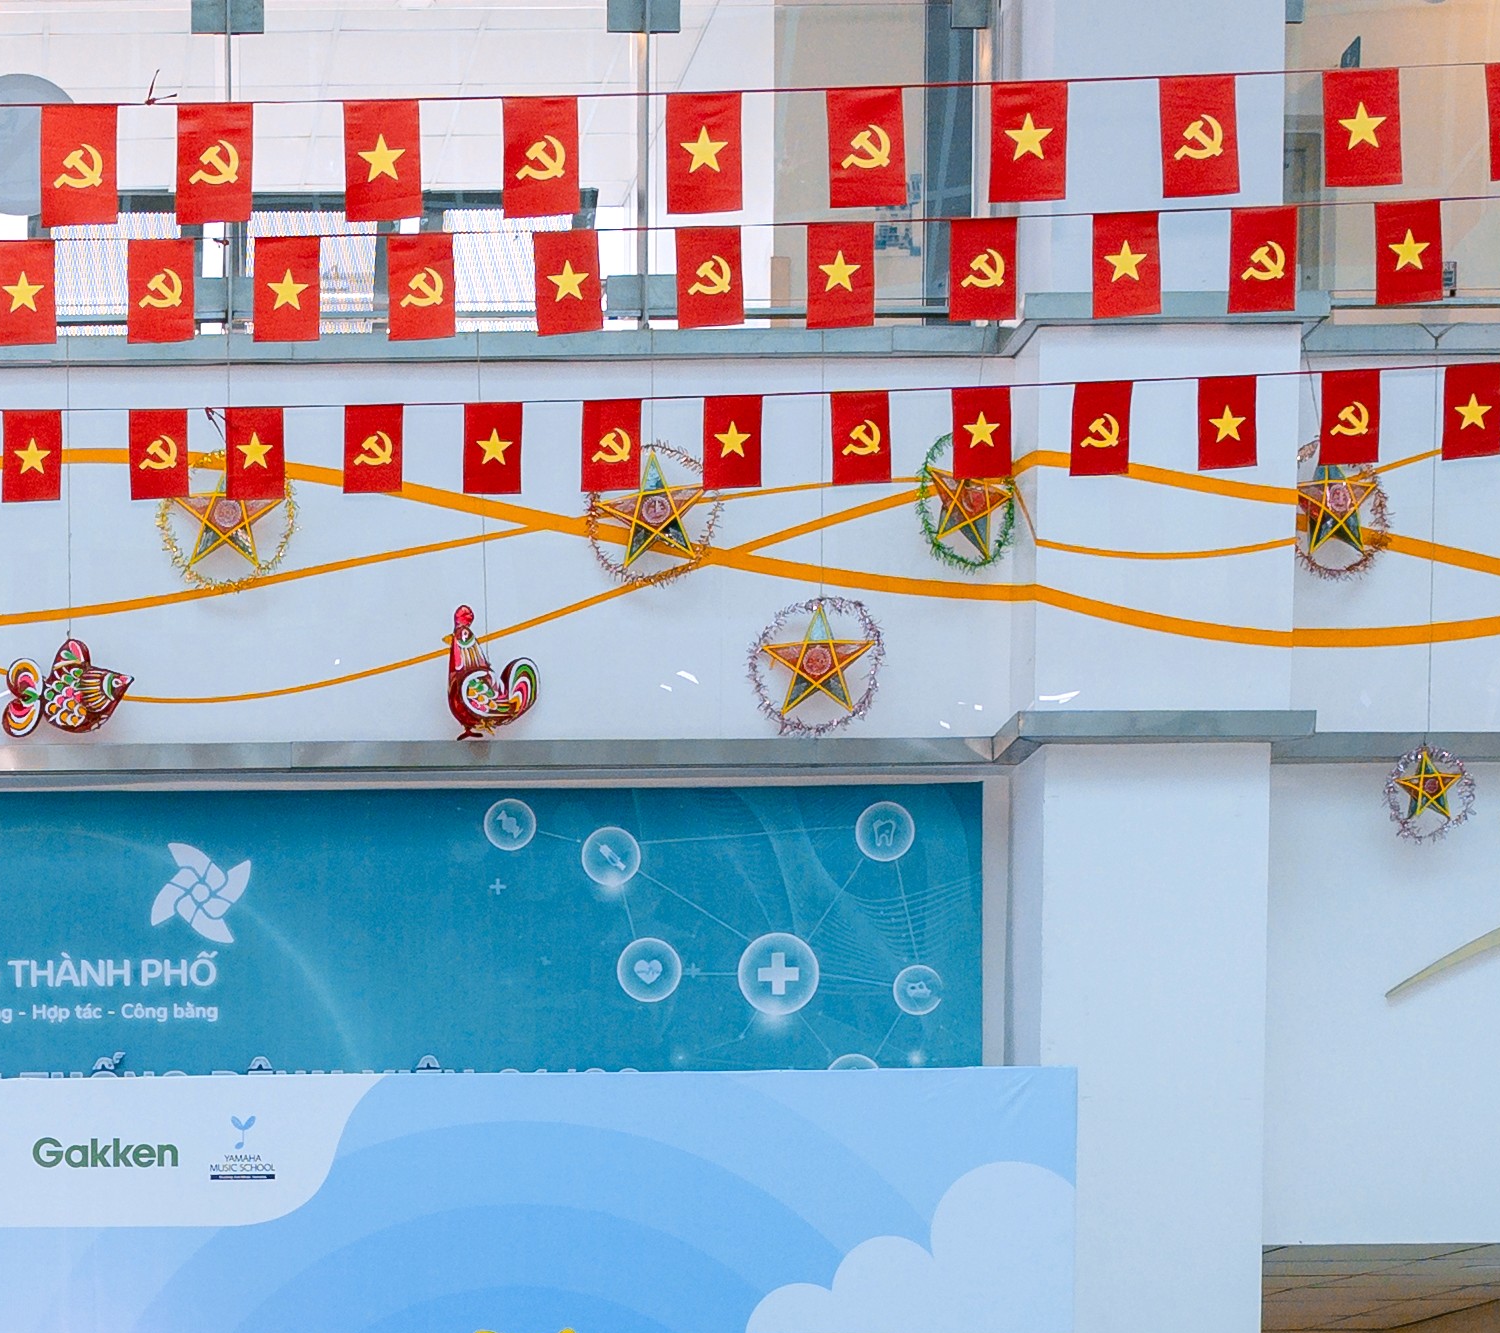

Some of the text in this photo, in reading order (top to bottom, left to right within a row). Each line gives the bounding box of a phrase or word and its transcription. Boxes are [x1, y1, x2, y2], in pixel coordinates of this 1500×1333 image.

[7, 951, 131, 988] THÀNH
[140, 951, 219, 988] PHỐ
[32, 1003, 70, 1024] Hợp
[74, 1003, 103, 1021] tác
[121, 1003, 168, 1023] Công
[172, 1001, 219, 1023] bằng
[32, 1137, 179, 1169] Gakken
[224, 1154, 262, 1162] YAMAHA
[209, 1163, 275, 1172] MUSIC SCHOOL
